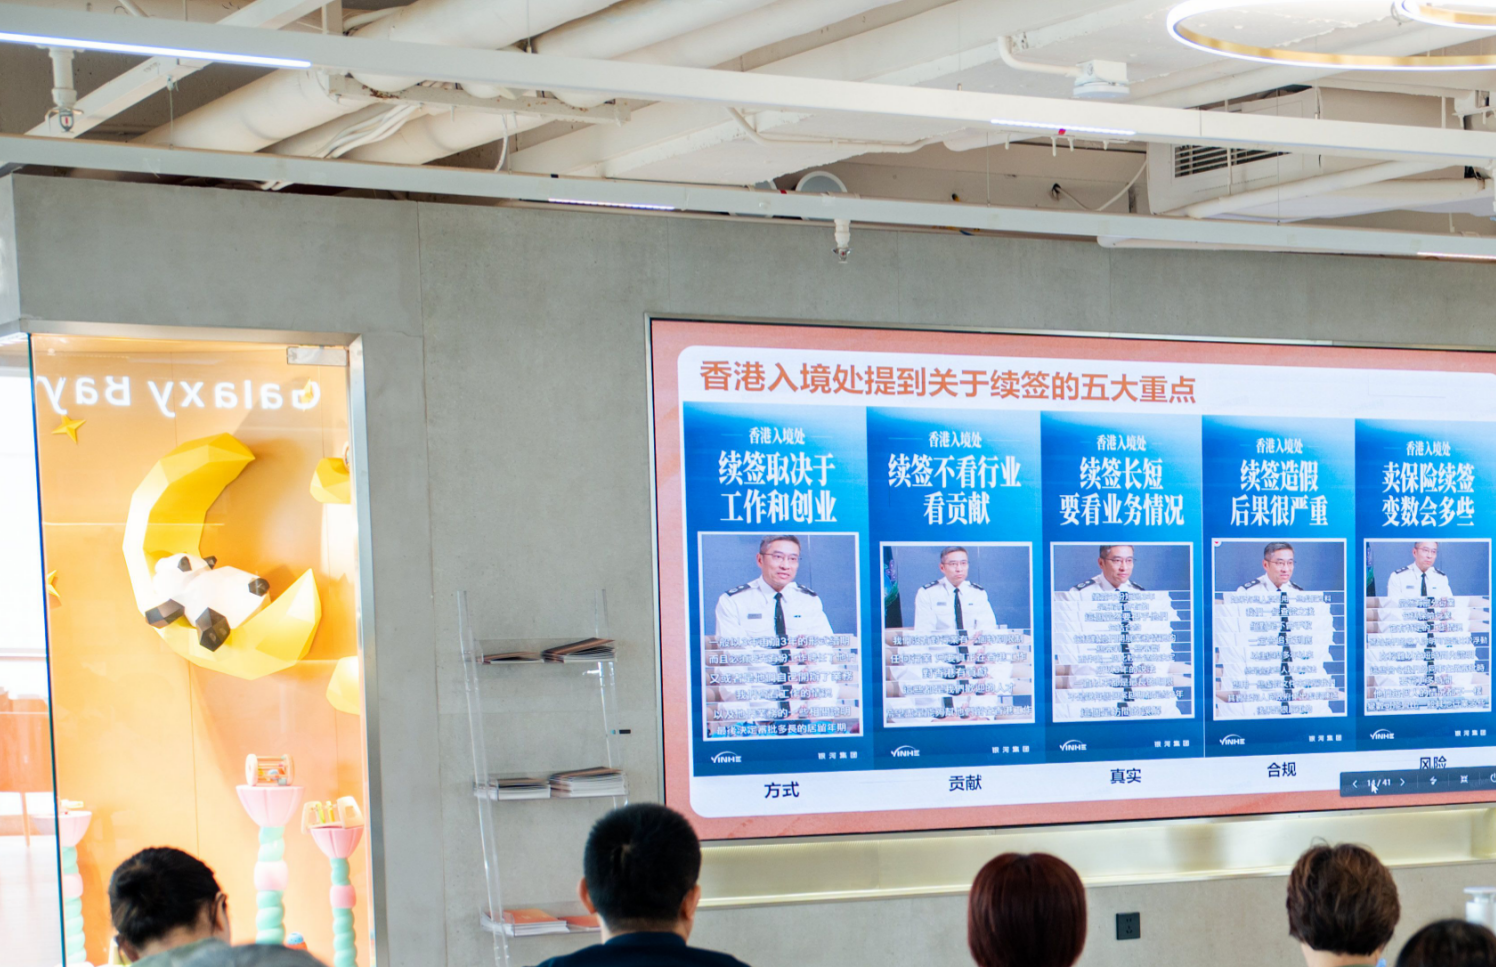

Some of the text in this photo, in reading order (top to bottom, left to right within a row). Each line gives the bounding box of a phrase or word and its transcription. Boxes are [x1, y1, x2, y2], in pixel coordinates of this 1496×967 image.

[700, 360, 1197, 404] 香港入境处提到关于续签的五大重点
[749, 427, 805, 445] 香港入境处
[929, 431, 982, 448] 香港入境处
[1097, 434, 1147, 451] 香港入境处
[1256, 438, 1304, 454] 香港入境处
[1406, 440, 1452, 456] 香港入境处
[718, 450, 835, 487] 续签取决于
[888, 454, 1021, 488] 续签不看行业
[1080, 457, 1163, 490] 续签长短
[1240, 459, 1319, 492] 续签造假
[1382, 461, 1475, 494] 卖保险续签
[720, 489, 837, 524] 工作和创业
[923, 491, 990, 526] 看贡献
[1060, 493, 1184, 527] 要看业务情况
[1230, 494, 1328, 527] 后果很严重
[1382, 495, 1475, 527] 变数会多些
[949, 775, 982, 792] 贡献
[1110, 768, 1142, 785] 真实
[1267, 761, 1297, 778] 合规
[764, 782, 799, 799] 方式
